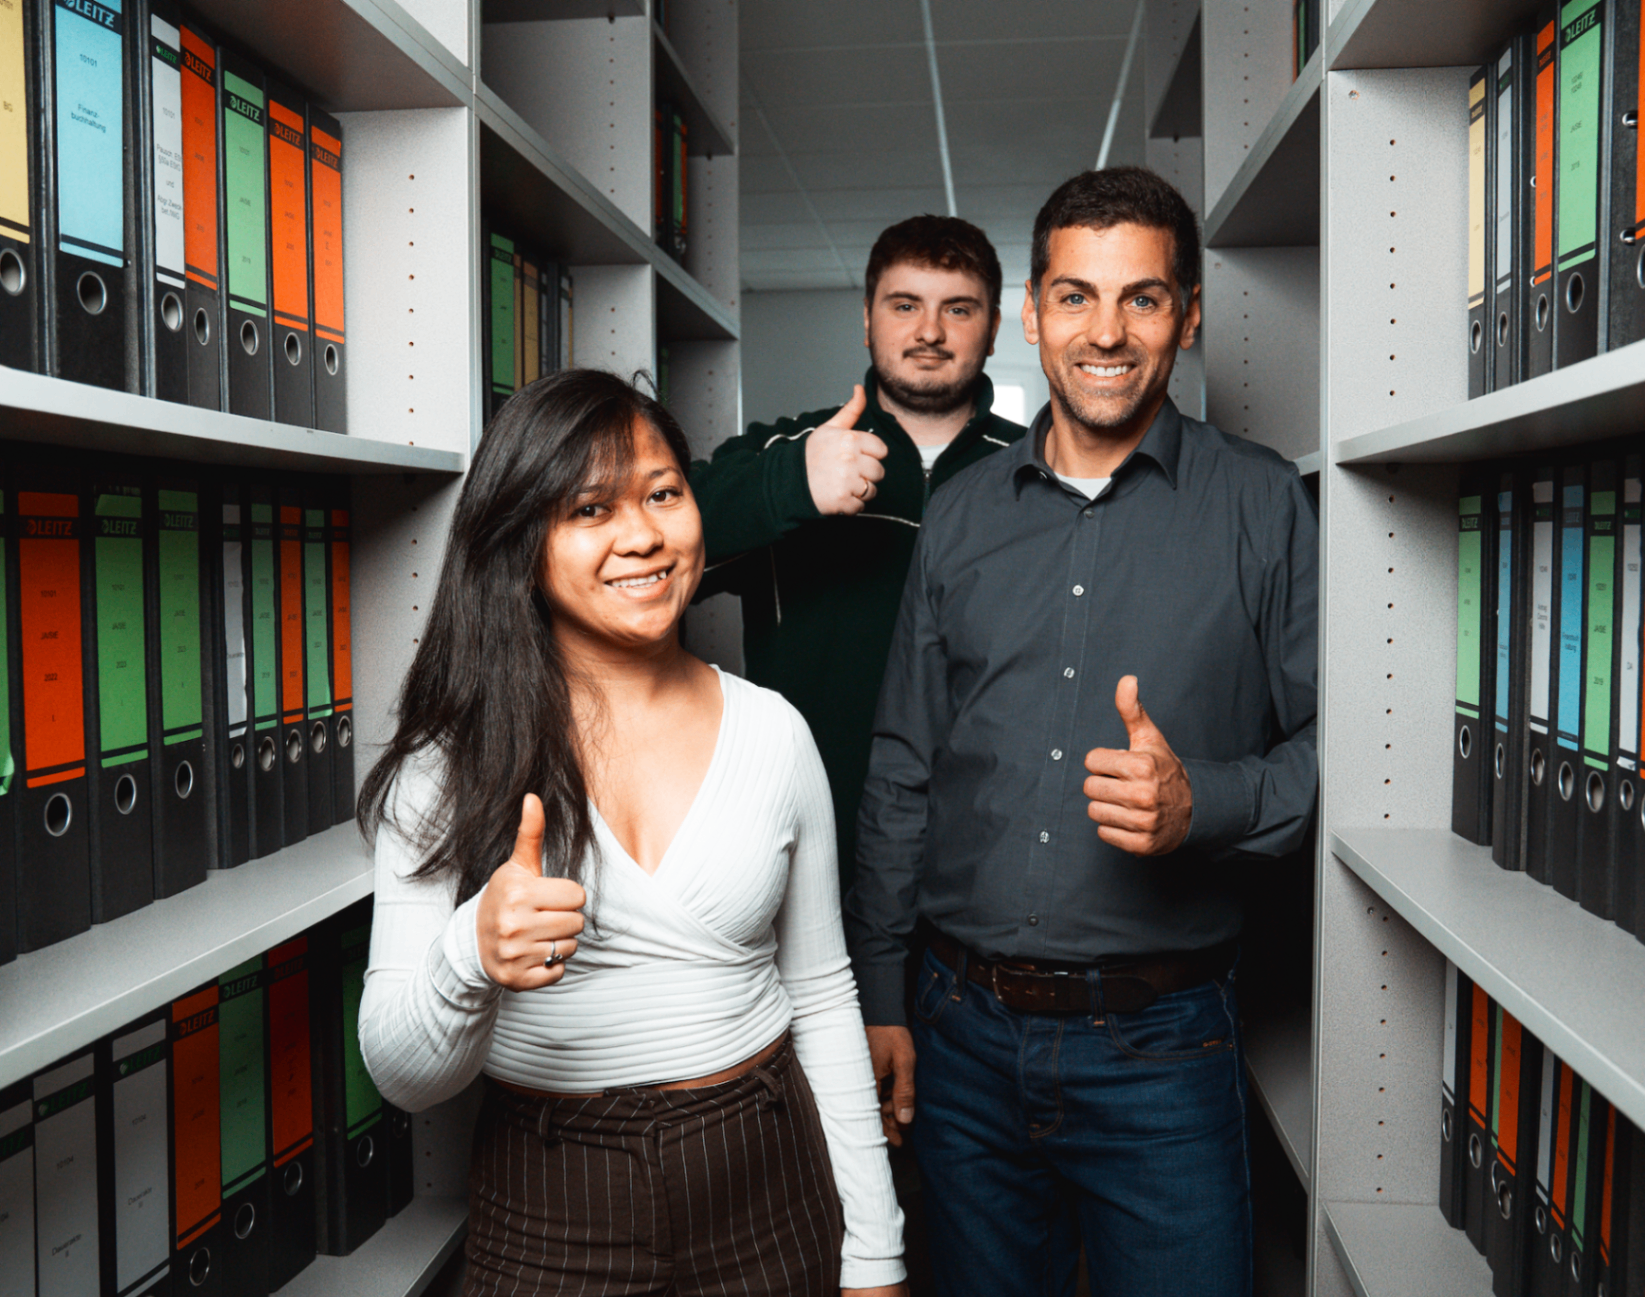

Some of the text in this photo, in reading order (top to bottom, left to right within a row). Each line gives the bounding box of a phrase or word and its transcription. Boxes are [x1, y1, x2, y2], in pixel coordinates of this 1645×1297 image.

[75, 0, 115, 28] LEITZ
[1570, 8, 1596, 39] LEITZ
[79, 53, 98, 68] 10101
[161, 47, 177, 64] LEITZ
[191, 56, 212, 82] LEITZ
[237, 101, 260, 121] LEITZ
[280, 127, 301, 147] LEITZ
[320, 150, 338, 168] LEITZ
[38, 520, 72, 536] LEITZ
[109, 520, 137, 535] LEITZ
[170, 514, 194, 528] LEITZ
[231, 975, 258, 996] LEITZ
[187, 1010, 215, 1032] LEITZ
[129, 1046, 161, 1072] LEITZ
[50, 1083, 88, 1112] LEITZ
[128, 1187, 152, 1206] Dauerakte
[52, 1234, 82, 1256] Dauerakte
